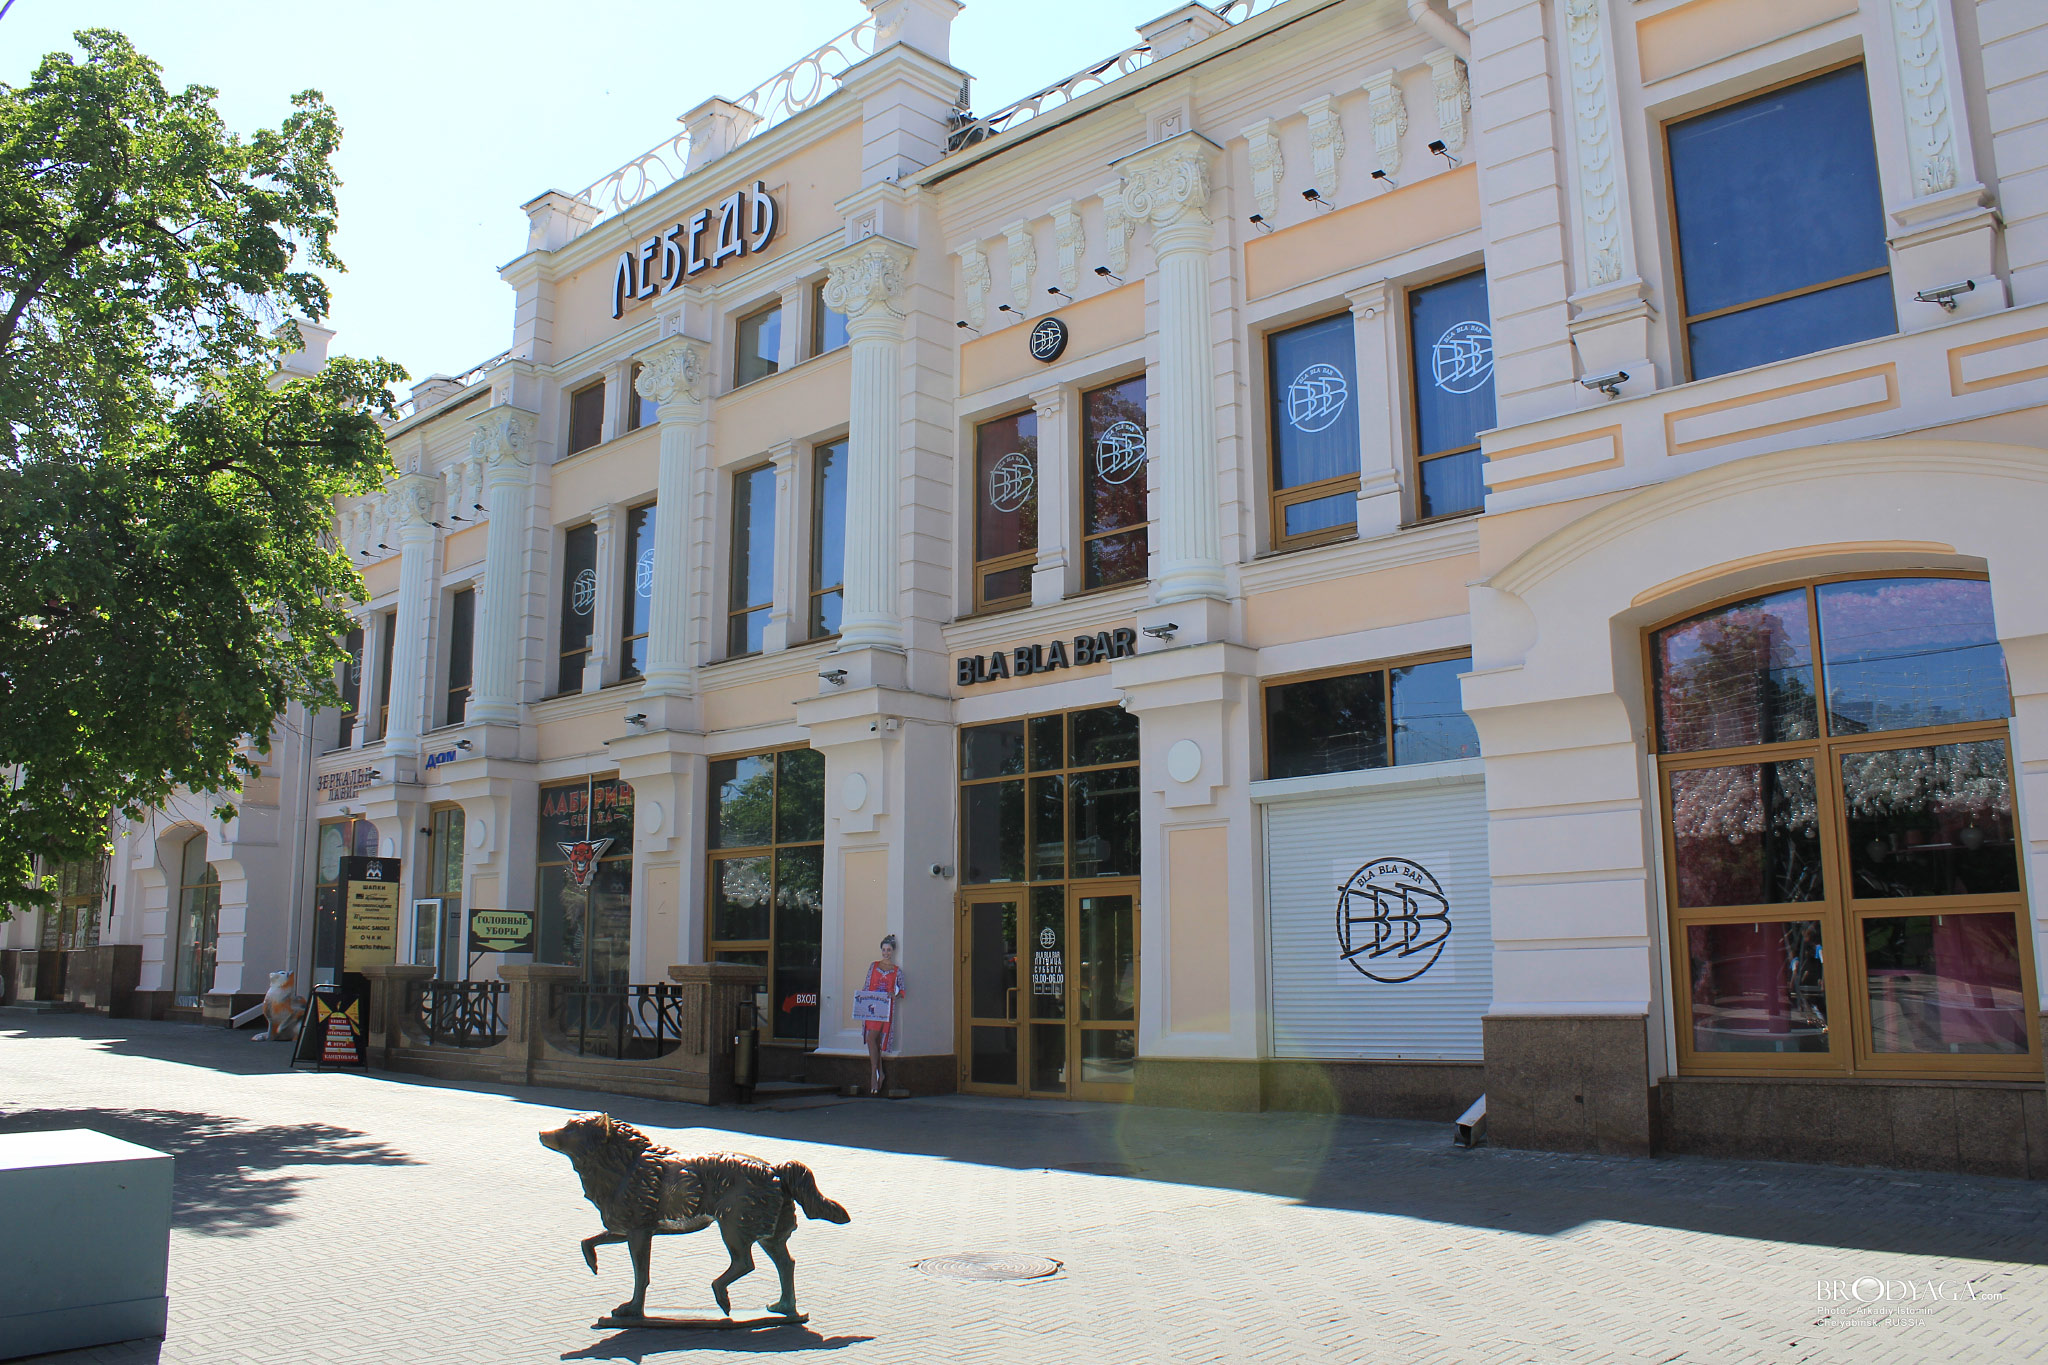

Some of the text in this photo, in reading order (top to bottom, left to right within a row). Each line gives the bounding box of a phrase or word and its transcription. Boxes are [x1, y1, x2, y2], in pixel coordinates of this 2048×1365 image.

[612, 180, 779, 320] ЛЕБЕДЬ
[1456, 325, 1469, 334] BLA
[1470, 325, 1483, 334] BAR
[957, 627, 1137, 686] BLA BLA BAR
[1356, 864, 1424, 887] BLA BLA BAR
[476, 915, 528, 926] ГОЛОВНЫЕ
[485, 926, 519, 936] УБОРЫ
[796, 994, 817, 1005] ВХОД
